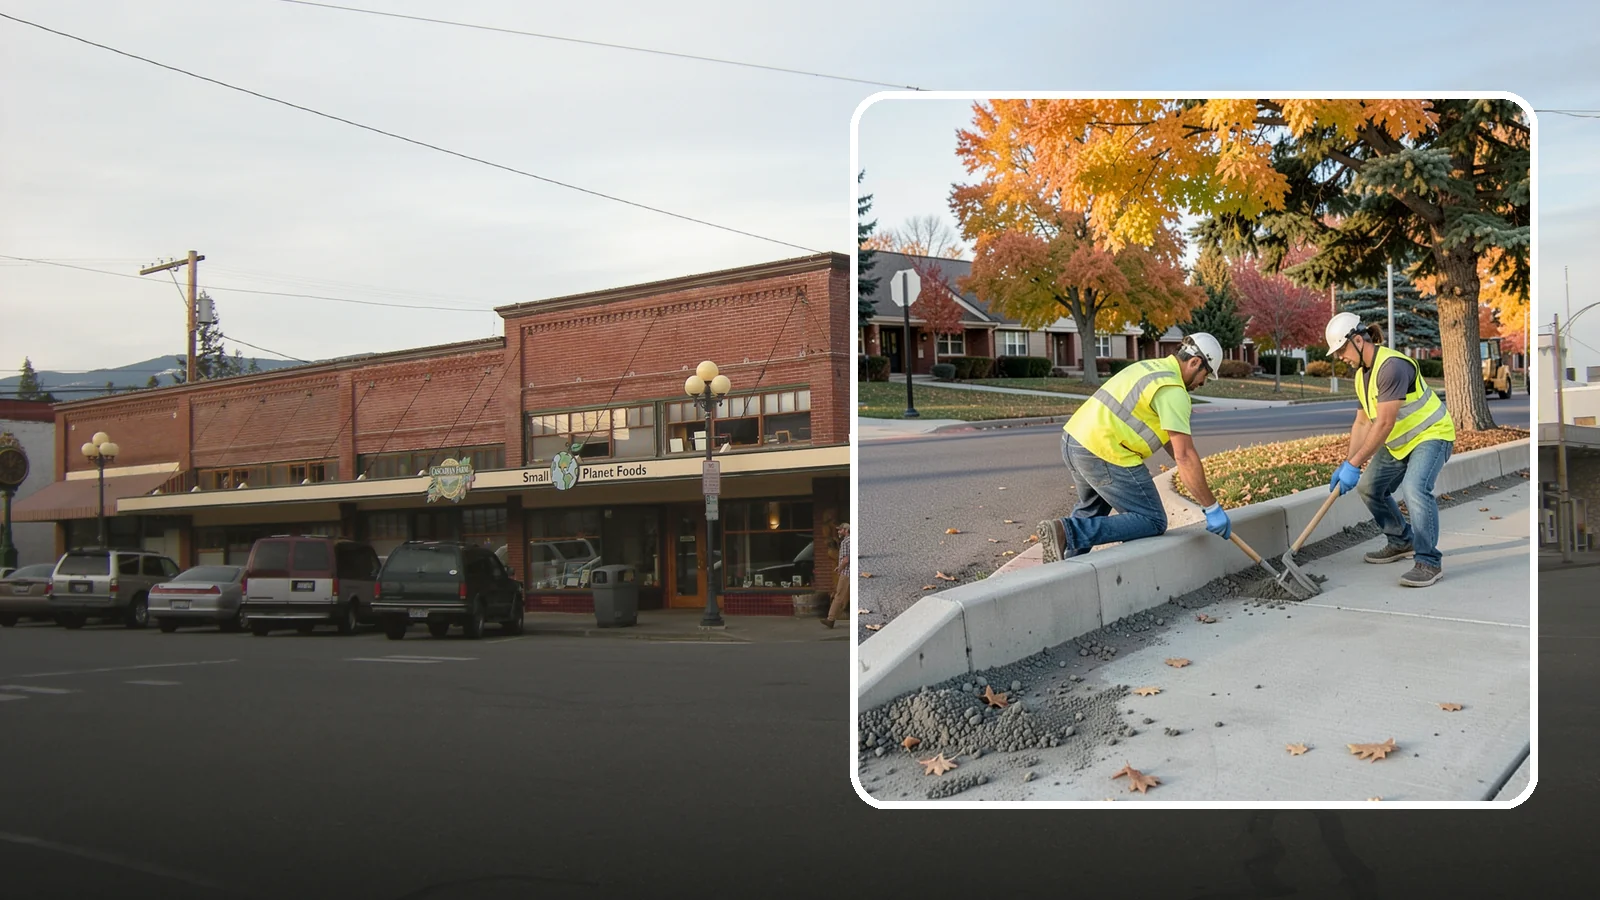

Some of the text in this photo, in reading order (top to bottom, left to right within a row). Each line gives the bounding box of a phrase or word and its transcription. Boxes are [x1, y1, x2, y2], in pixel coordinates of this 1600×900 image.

[523, 464, 647, 483] Small Planet Foods
